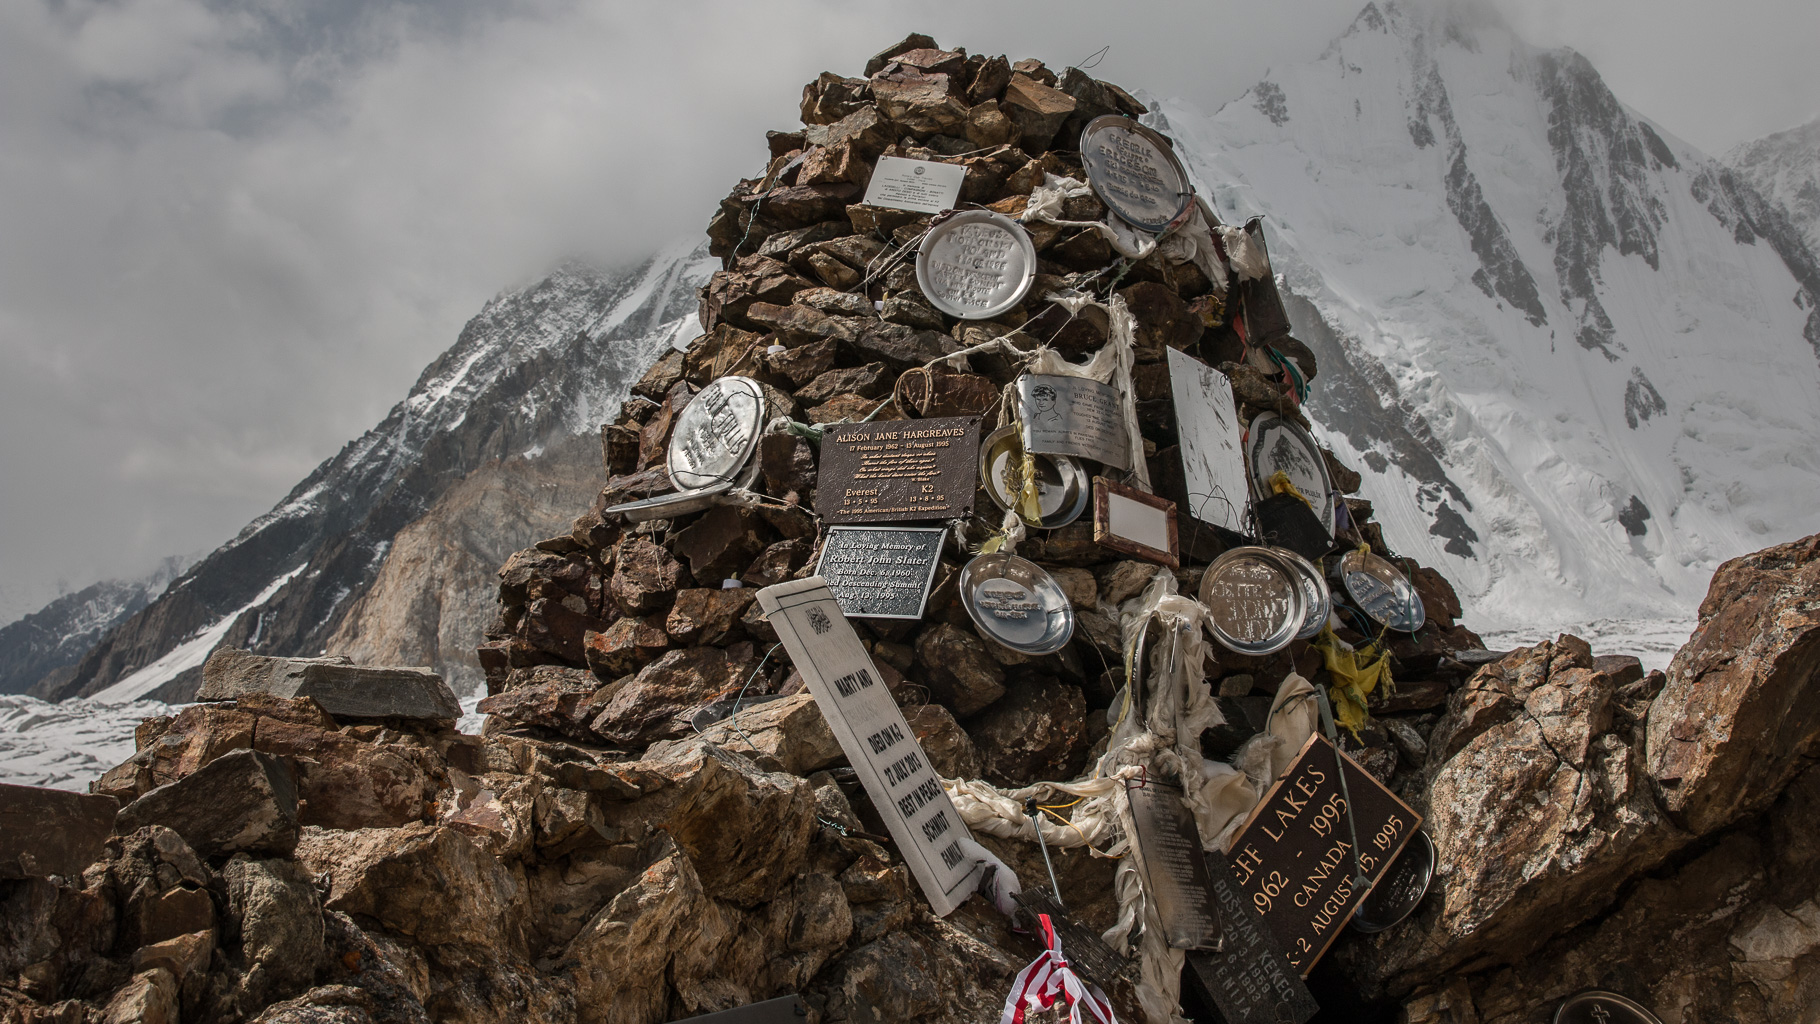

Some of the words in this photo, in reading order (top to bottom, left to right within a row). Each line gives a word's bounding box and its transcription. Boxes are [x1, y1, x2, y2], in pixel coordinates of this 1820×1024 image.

[1074, 392, 1097, 402] BRUCE
[1099, 398, 1120, 411] GRANT
[836, 433, 870, 443] ALISON
[875, 432, 898, 441] JANE
[903, 428, 965, 439] HARGREAVES
[846, 488, 878, 497] Everest
[922, 485, 934, 493] K2
[850, 542, 879, 551] Loving
[881, 543, 913, 551] Memory
[915, 543, 926, 551] of
[830, 555, 865, 564] Robert
[867, 555, 892, 564] John
[895, 555, 927, 565] Slater
[839, 592, 857, 600] Aug.
[861, 592, 872, 600] 13,
[876, 592, 895, 600] 1995
[842, 580, 888, 589] Descending
[890, 581, 922, 589] Summit
[834, 673, 861, 698] MARTY
[855, 668, 873, 689] AND
[867, 733, 887, 755] DIED
[881, 727, 895, 747] ON
[888, 722, 904, 742] K-2
[884, 767, 898, 787] 27
[892, 759, 910, 782] JULY
[904, 751, 922, 774] 2013
[912, 789, 926, 808] IN
[918, 777, 941, 803] PEACE
[898, 794, 918, 819] REST
[922, 810, 950, 843] SCHMIDT
[1231, 842, 1263, 886] EFF
[1260, 764, 1326, 843] LAKES
[941, 840, 964, 871] FAMILY
[1253, 870, 1290, 916] 1962
[1309, 793, 1347, 838] 1995
[1293, 839, 1352, 908] CANADA
[1310, 875, 1354, 936] AUGUST
[1373, 814, 1403, 851] 1995
[1214, 879, 1261, 947] BOŠTJAN
[1257, 949, 1295, 1002] KEKEC
